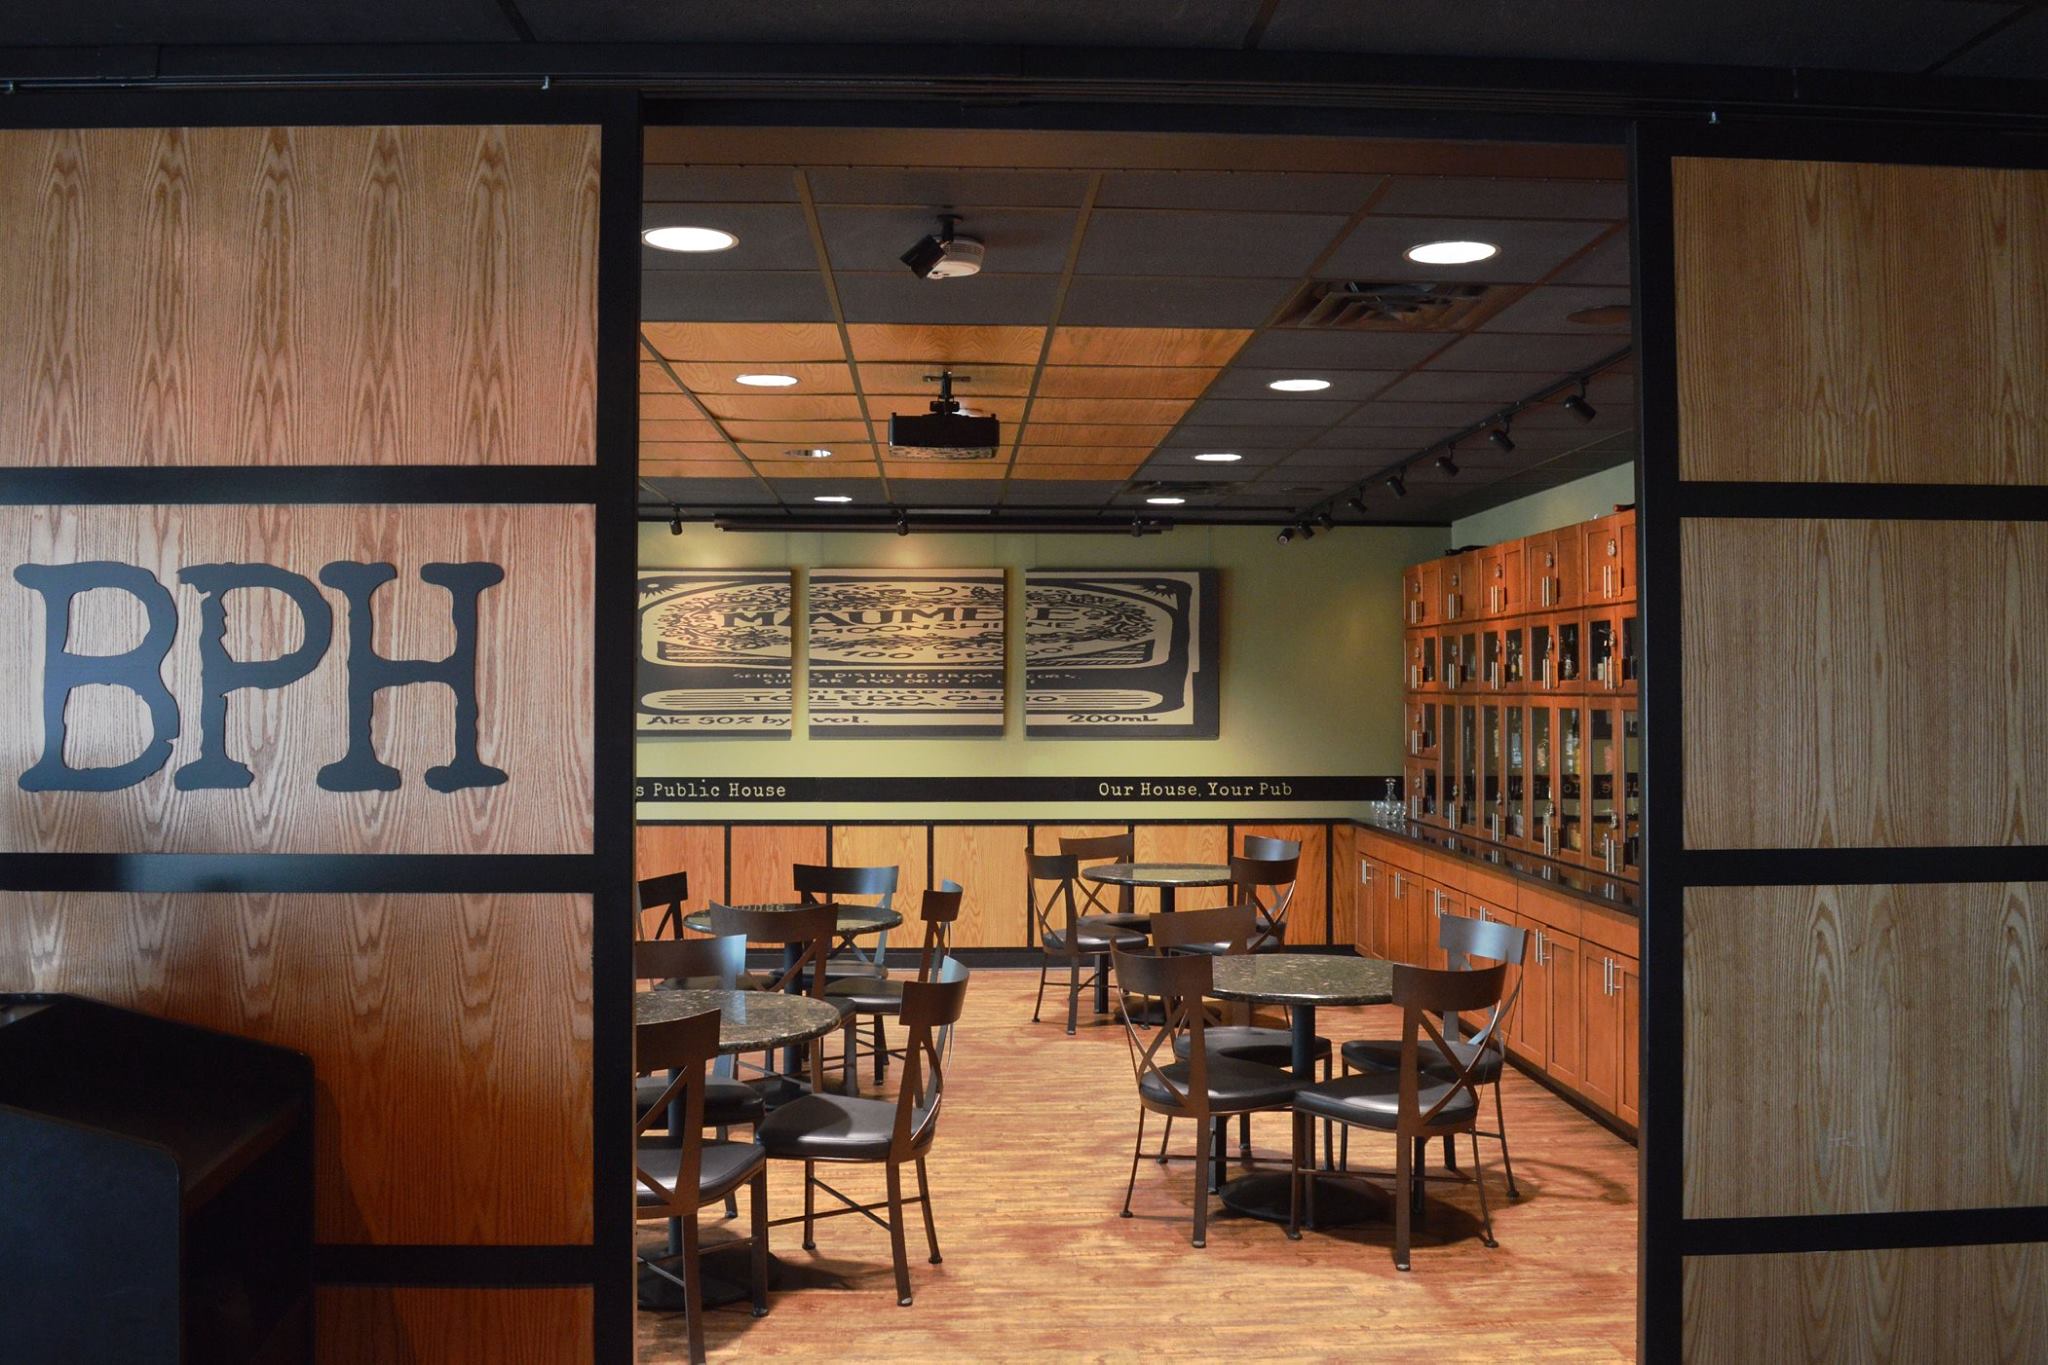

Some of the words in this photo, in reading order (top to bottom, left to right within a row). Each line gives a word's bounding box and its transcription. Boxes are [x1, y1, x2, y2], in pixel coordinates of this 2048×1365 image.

[723, 607, 1080, 628] MAUMEE
[811, 622, 1076, 635] MOONSHINE
[841, 651, 914, 659] 100
[13, 561, 508, 793] BPH
[762, 715, 791, 727] by
[1067, 714, 1159, 724] 200mL
[653, 778, 720, 797] Public
[729, 782, 786, 797] House
[1099, 782, 1134, 796] Our
[1207, 782, 1254, 796] Your
[1259, 782, 1293, 796] Pub
